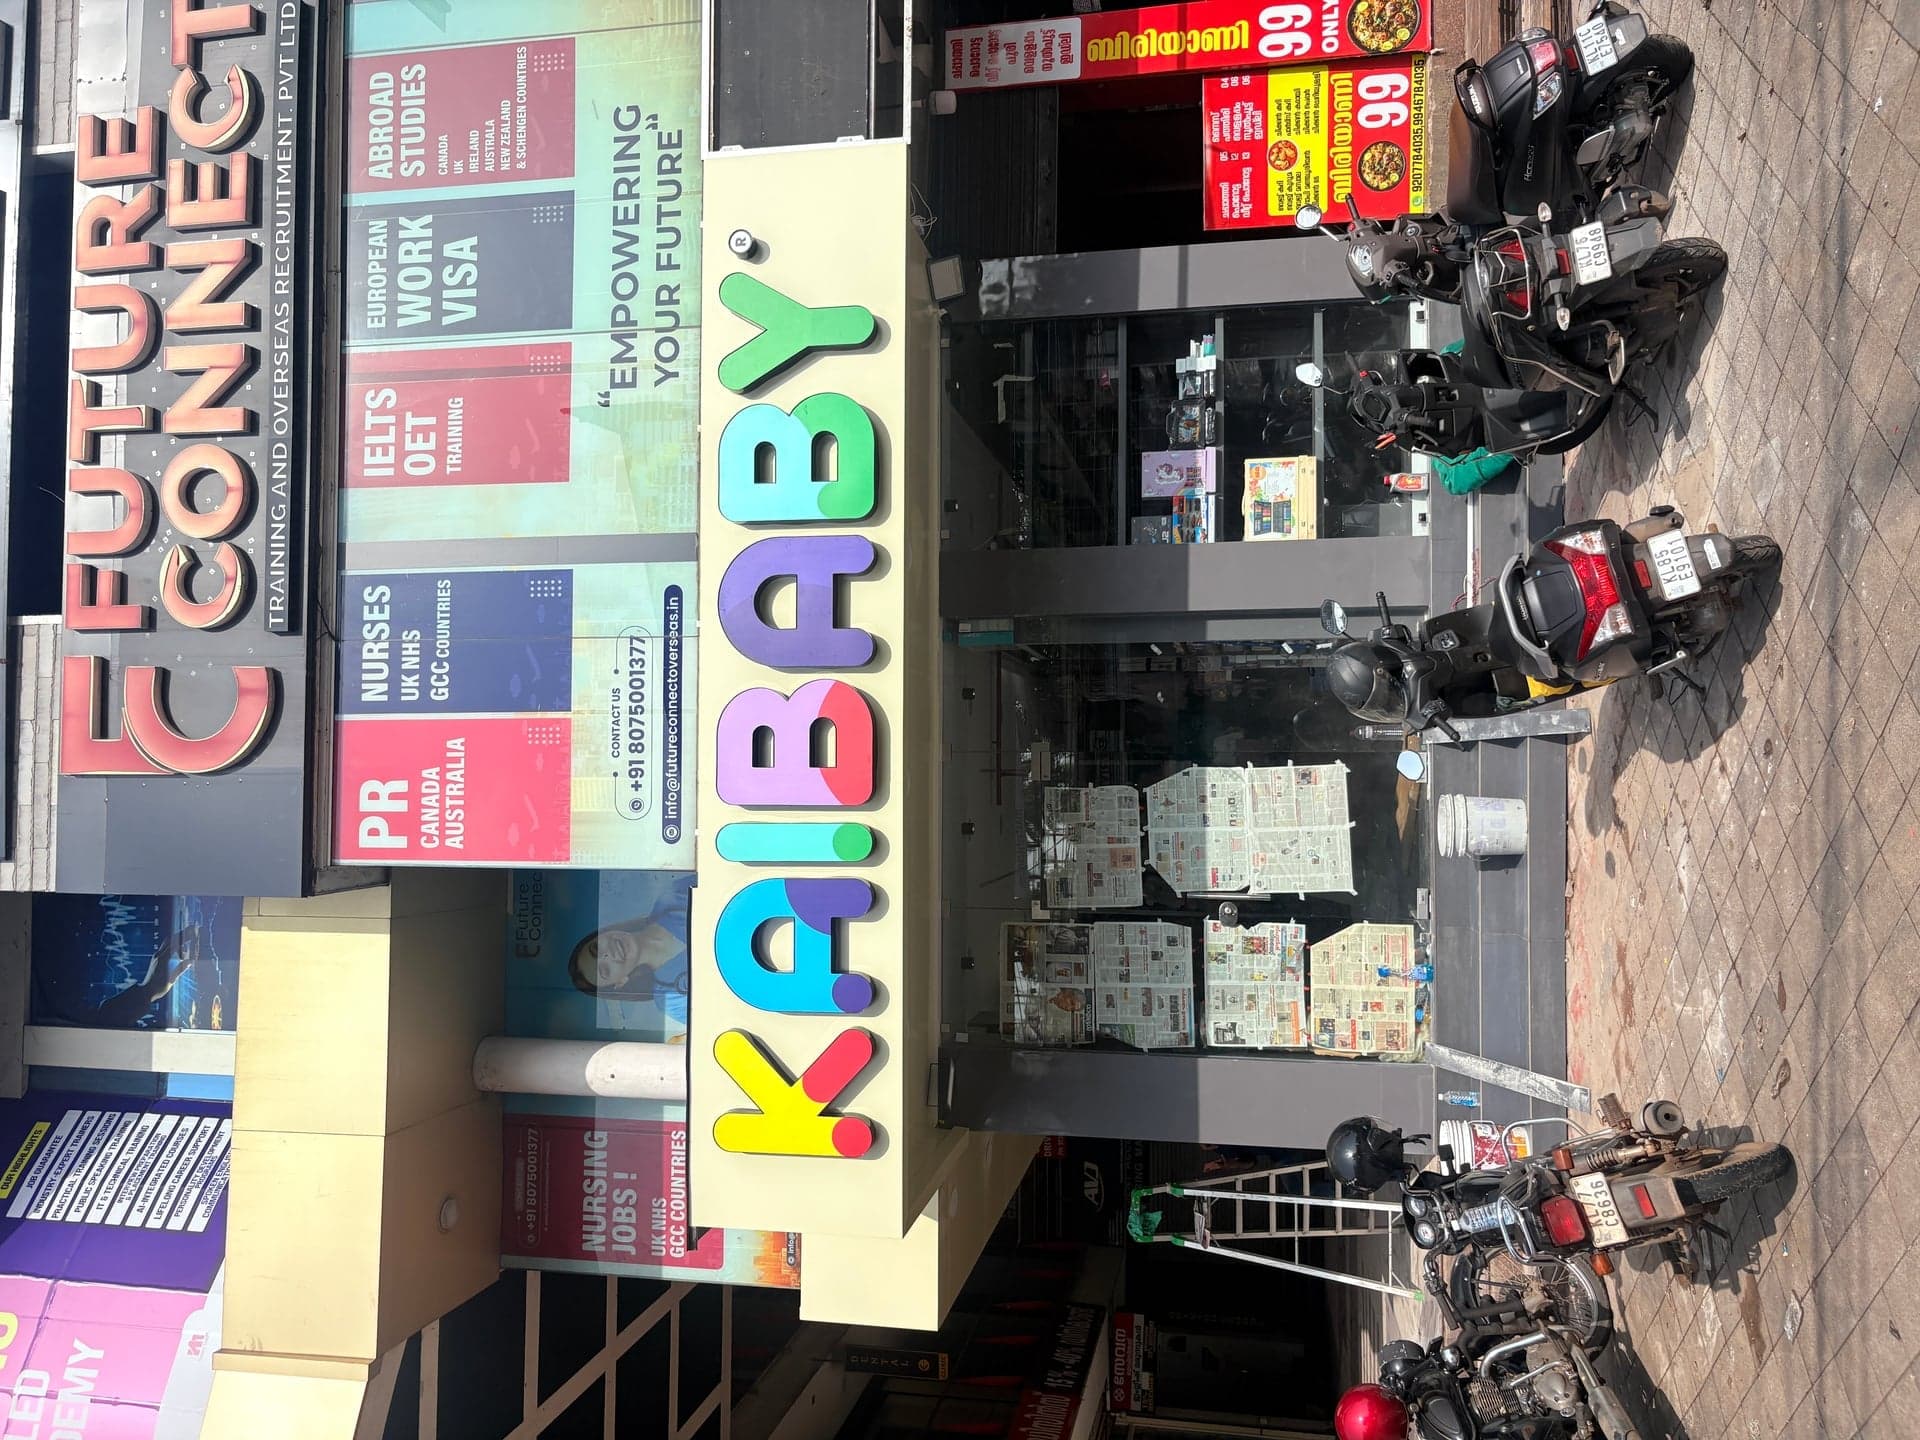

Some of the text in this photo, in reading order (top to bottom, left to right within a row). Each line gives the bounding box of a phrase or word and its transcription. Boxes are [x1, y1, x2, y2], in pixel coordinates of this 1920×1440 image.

[1257, 3, 1313, 58] 99
[1321, 0, 1340, 53] ONLY
[368, 70, 395, 179] ABROAD
[399, 63, 427, 177] STUDIES
[500, 99, 512, 171] NEW ZEALAND
[516, 46, 528, 169] & SCHENGEN COUNTRIES
[1356, 73, 1409, 129] 99
[437, 134, 449, 175] CANADA
[453, 160, 464, 174] UK
[468, 129, 480, 173] IRELAND
[484, 119, 496, 172] AUSTRALA
[366, 219, 388, 329] EUROPEAN
[397, 214, 433, 328] WORK
[440, 236, 478, 326] VISA
[158, 0, 257, 629] CONNECT
[268, 2, 298, 628] TRAINING AND OVERSEAS RECRUITMENT. PVT LTD
[652, 284, 682, 387] YOUR
[64, 105, 159, 631] FUTURE
[363, 388, 398, 477] IELTS
[404, 412, 437, 476] OET
[446, 396, 464, 474] TRAINING
[1654, 548, 1678, 585] KL85
[1667, 537, 1694, 581] E9101
[361, 584, 391, 702] NURSES
[401, 629, 421, 701] UK NHS
[430, 579, 452, 701] GCC COUNTRIES
[610, 687, 622, 758] CONTACT US
[628, 635, 647, 792] +91 8075001377
[664, 596, 681, 819] info@futureconnectoverseas.in
[712, 270, 876, 1157] KAIBABY
[358, 779, 409, 849] PR
[420, 767, 441, 849] CANADA
[445, 737, 466, 849] AUSTRALIA
[8, 1129, 43, 1173] HIGHLIGHTS
[26, 1135, 64, 1189] JOB GUARANTEE
[32, 1115, 96, 1214] INDUSTRY-EXPERT TRAINERS
[51, 1113, 117, 1219] PRACTICAL TRAINING SESSIONS
[73, 1119, 133, 1213] PUBLIC SPEAKING TRAINING
[102, 1157, 130, 1194] TECHNICAL
[124, 1124, 151, 1156] TRAINING
[116, 1172, 138, 1204] INTERVIEW
[136, 1127, 190, 1214] AI-INTEGRATED COURSES
[153, 1124, 212, 1220] LIFELONG CAREER SUPPORT
[173, 1130, 226, 1217] PERSONALITY DEVELOPMENT
[193, 1155, 218, 1189] PROGRAMS
[200, 1177, 219, 1205] SPOKEN
[581, 1130, 609, 1252] NURSING
[611, 1188, 638, 1256] JOBS
[650, 1197, 667, 1257] UK NHS
[670, 1130, 687, 1258] GCC COUNTRIES
[1589, 1179, 1620, 1227] C8636
